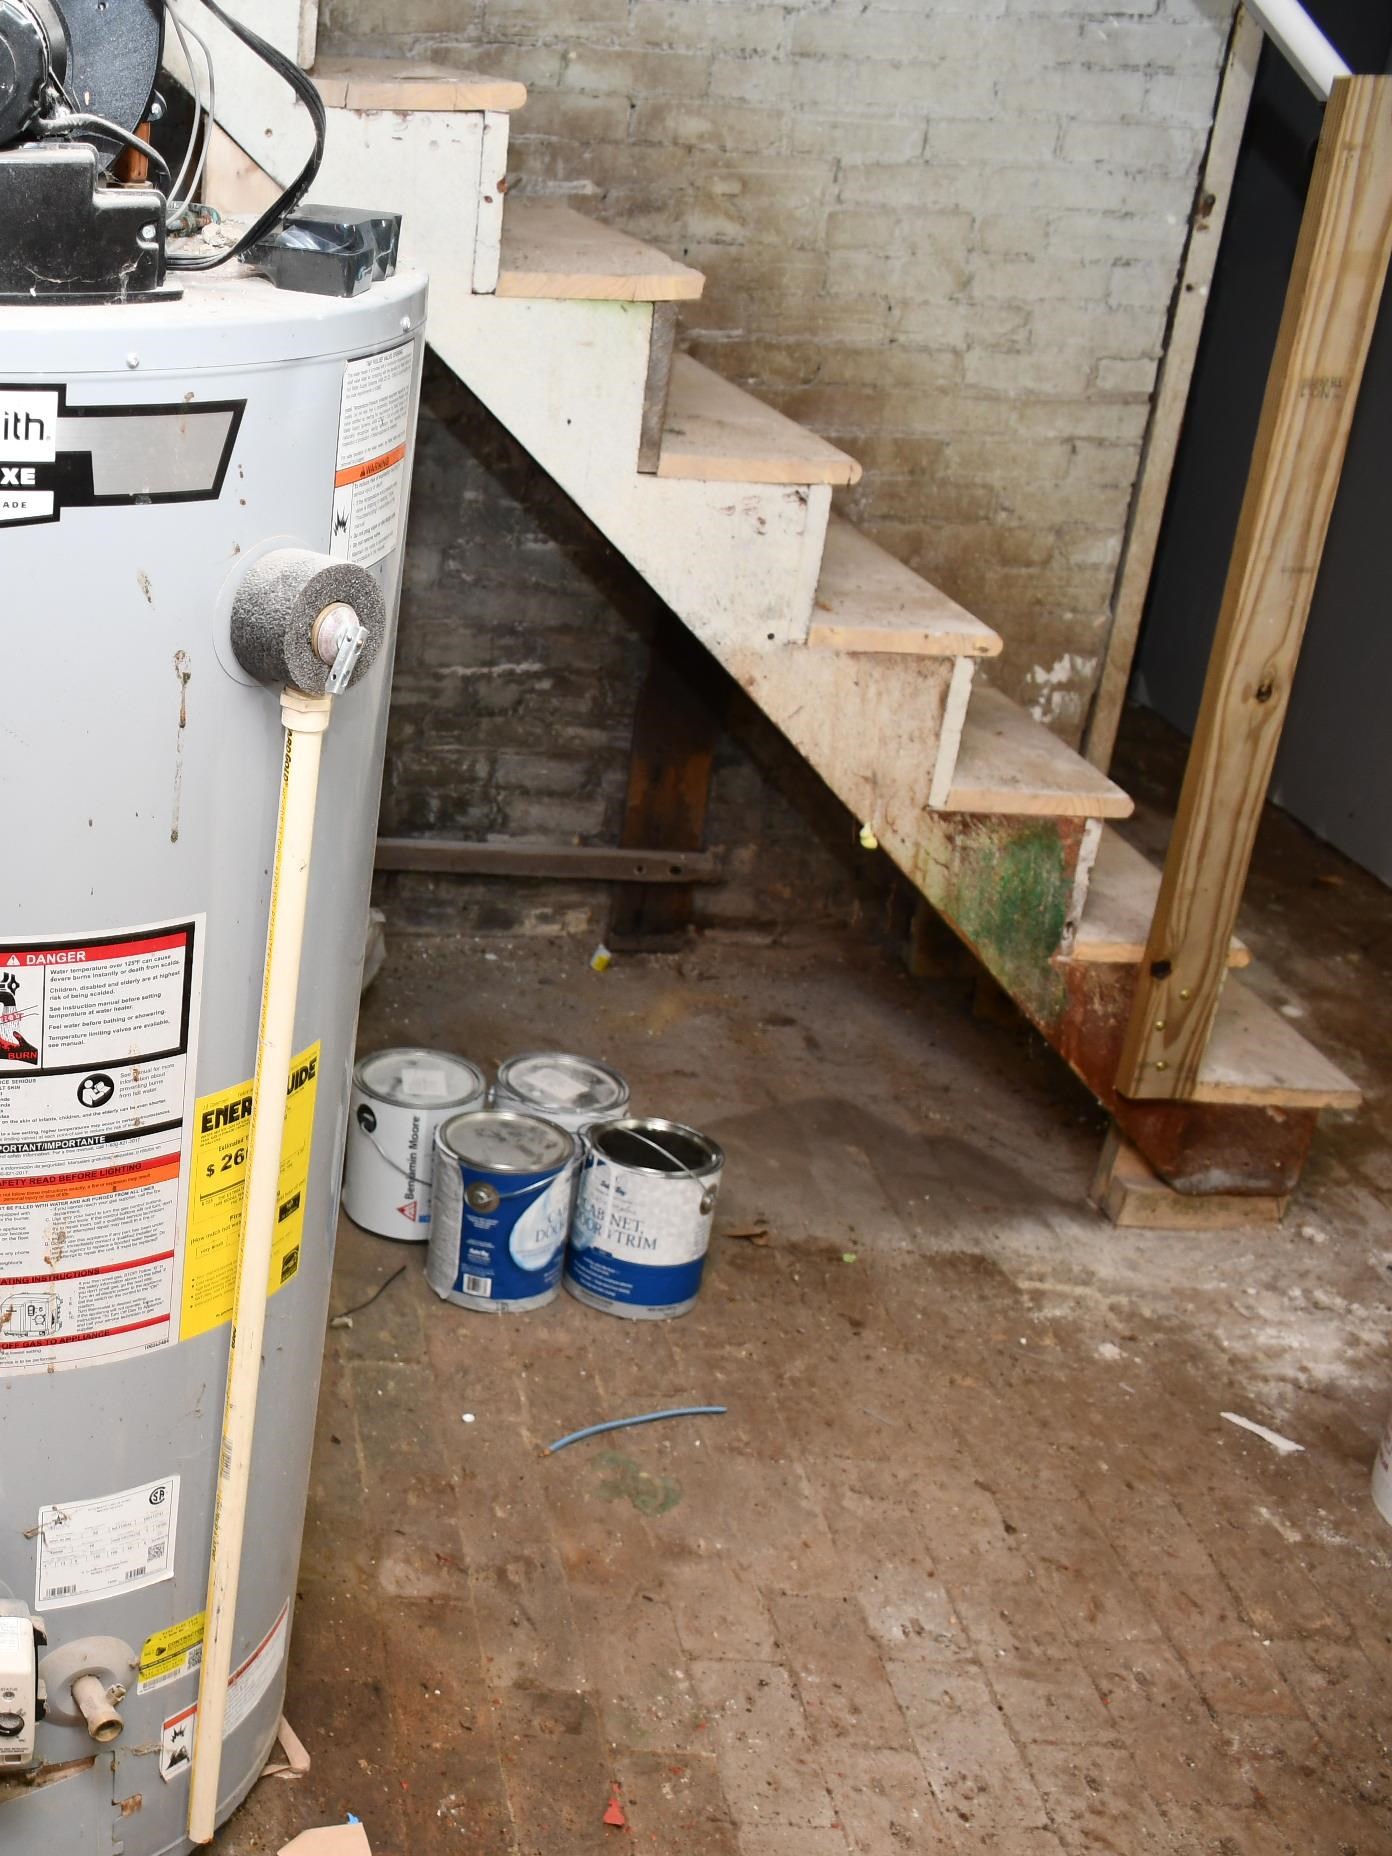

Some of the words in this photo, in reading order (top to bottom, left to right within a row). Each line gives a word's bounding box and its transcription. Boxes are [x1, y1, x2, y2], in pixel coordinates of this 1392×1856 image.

[0, 468, 36, 485] XE
[26, 951, 85, 965] DANGER
[9, 1052, 37, 1060] BURN
[409, 1116, 420, 1149] Moore
[206, 1164, 215, 1177] $
[220, 1148, 248, 1172] 26
[29, 1176, 56, 1184] READ
[59, 1171, 97, 1182] BEFORE
[100, 1163, 142, 1176] LIGHTING
[614, 1230, 657, 1250] TRIM
[32, 1268, 100, 1281] INSTRUCTIONS
[22, 1340, 42, 1348] GAS
[61, 1331, 109, 1344] APPLIANCE
